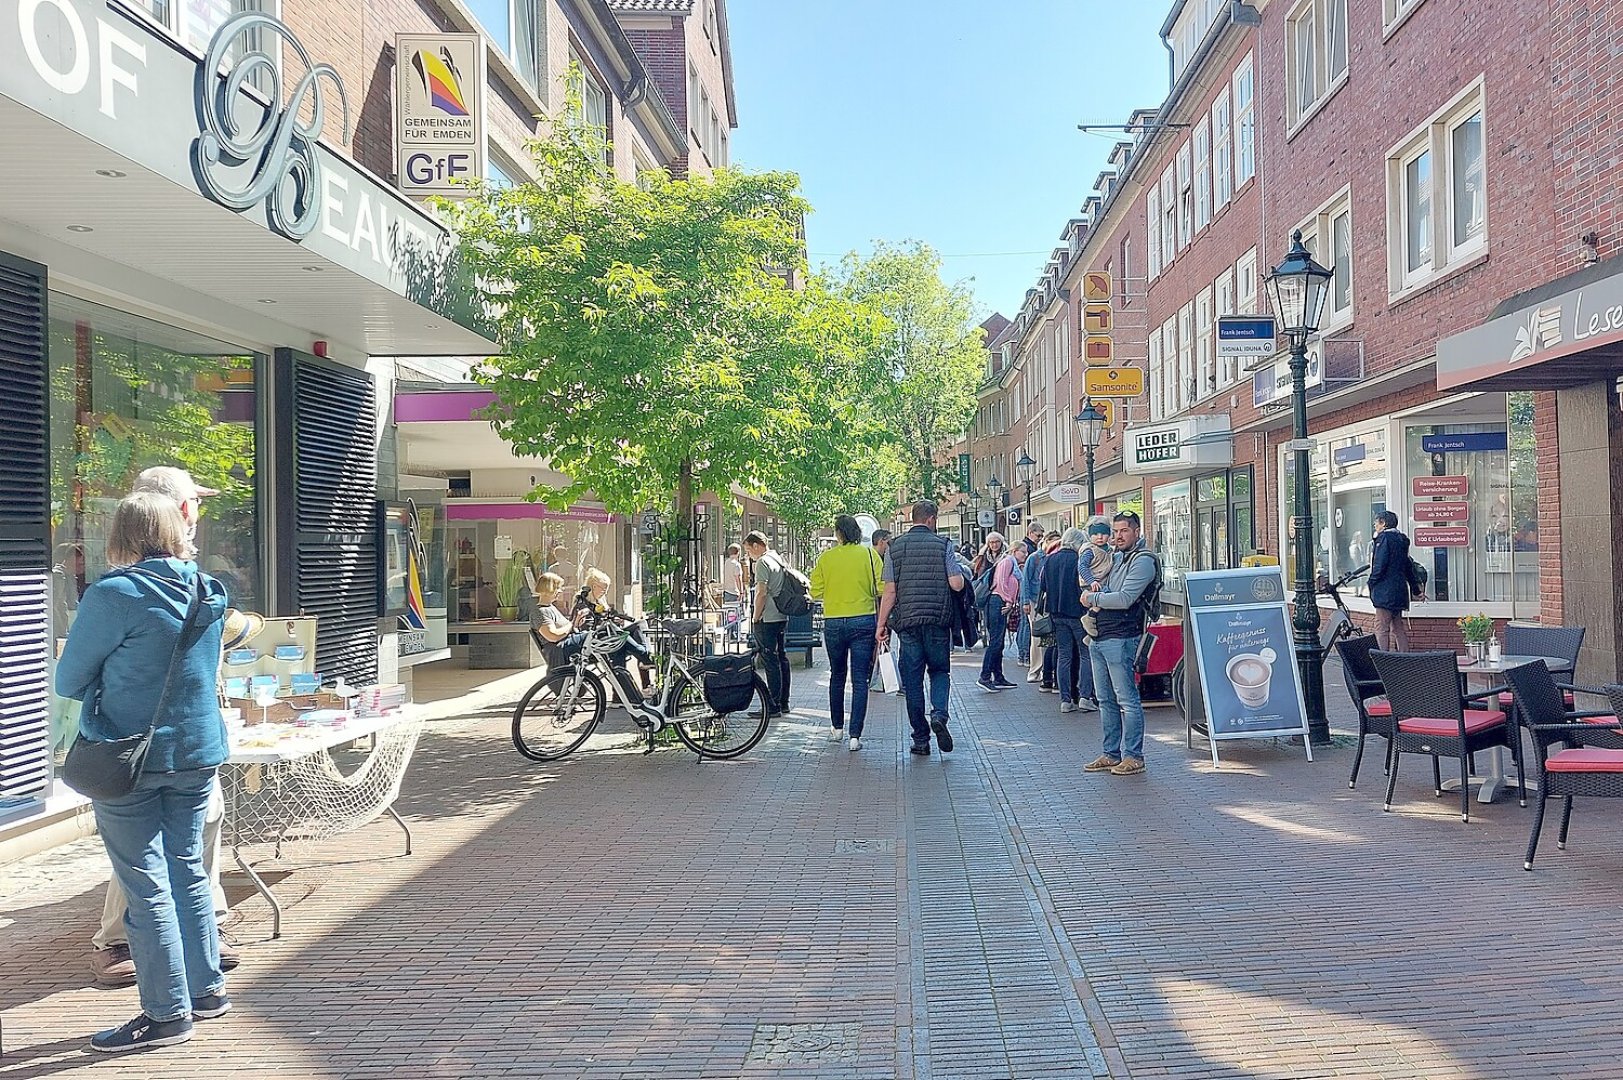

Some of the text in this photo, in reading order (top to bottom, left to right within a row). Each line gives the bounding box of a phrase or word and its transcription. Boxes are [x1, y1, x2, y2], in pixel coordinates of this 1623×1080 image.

[17, 0, 147, 120] OF
[405, 118, 472, 128] GEMEINSAM
[405, 129, 472, 139] FÜR EMDEN
[406, 153, 469, 185] GfE
[1235, 329, 1255, 337] Jentsch
[1090, 382, 1138, 392] Samsonite
[1138, 432, 1177, 448] LEDER
[1138, 447, 1178, 461] HÖFER
[1204, 593, 1236, 601] Dallmayr
[1216, 627, 1266, 645] Kaffeegenuss
